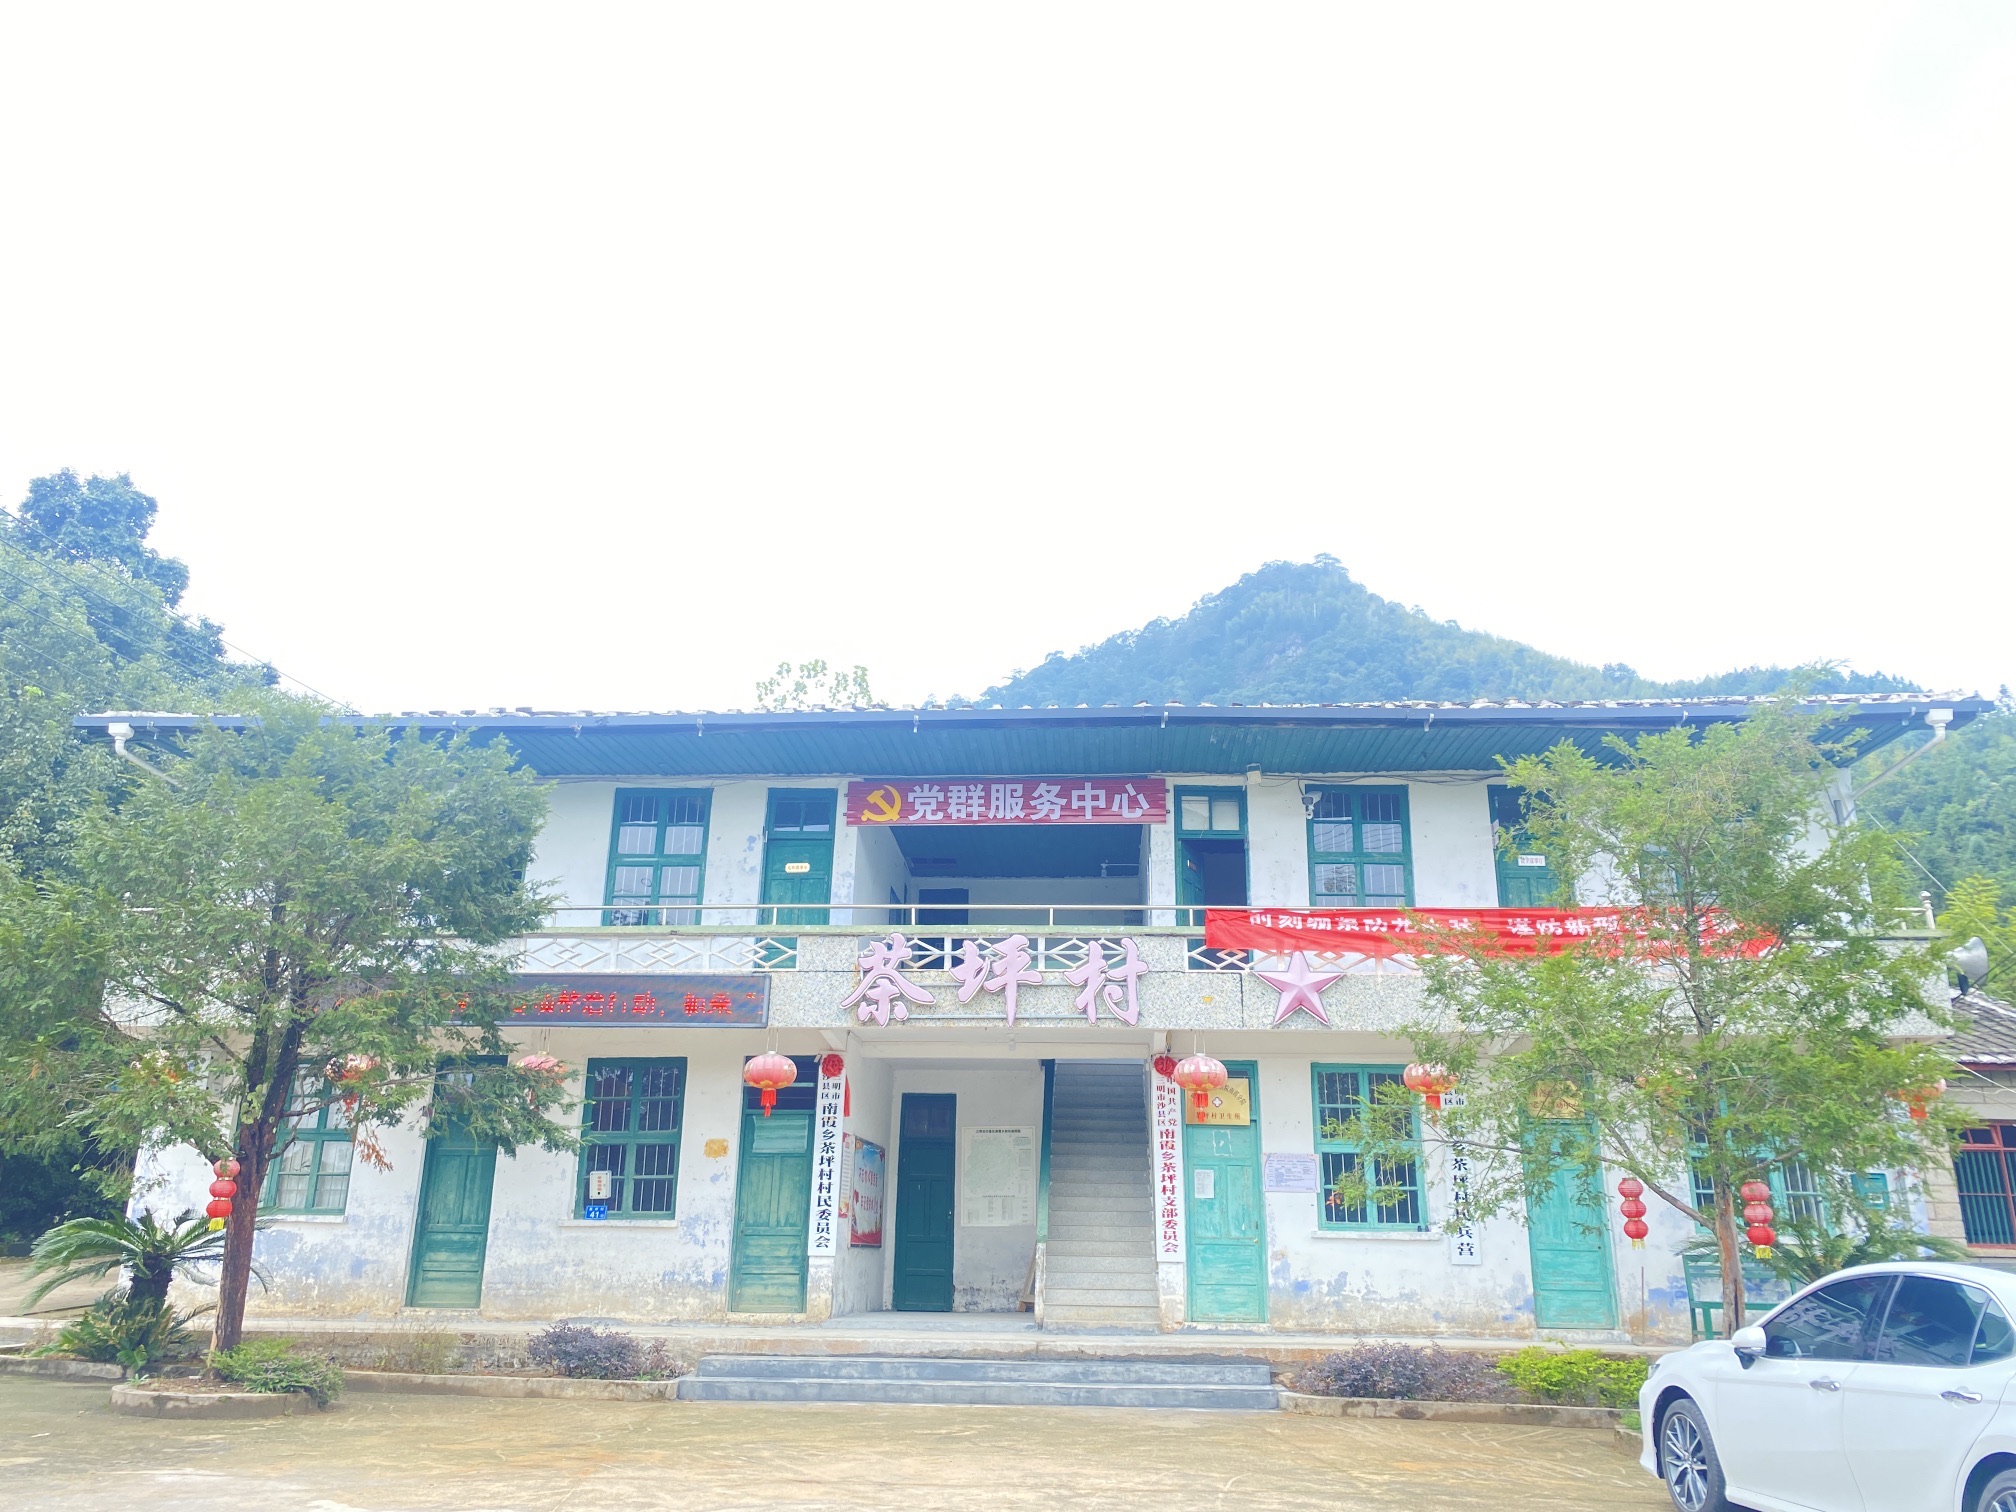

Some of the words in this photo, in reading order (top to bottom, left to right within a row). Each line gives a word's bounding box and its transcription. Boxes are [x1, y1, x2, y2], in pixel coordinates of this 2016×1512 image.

[908, 783, 1149, 820] 党群服务中心
[840, 932, 1149, 1027] 茶坪村
[1196, 1111, 1241, 1120] 坪村卫生所
[815, 1103, 838, 1249] 南霞乡茶坪村村民委员会
[1159, 1129, 1179, 1253] 南霞乡茶坪村支部委员会
